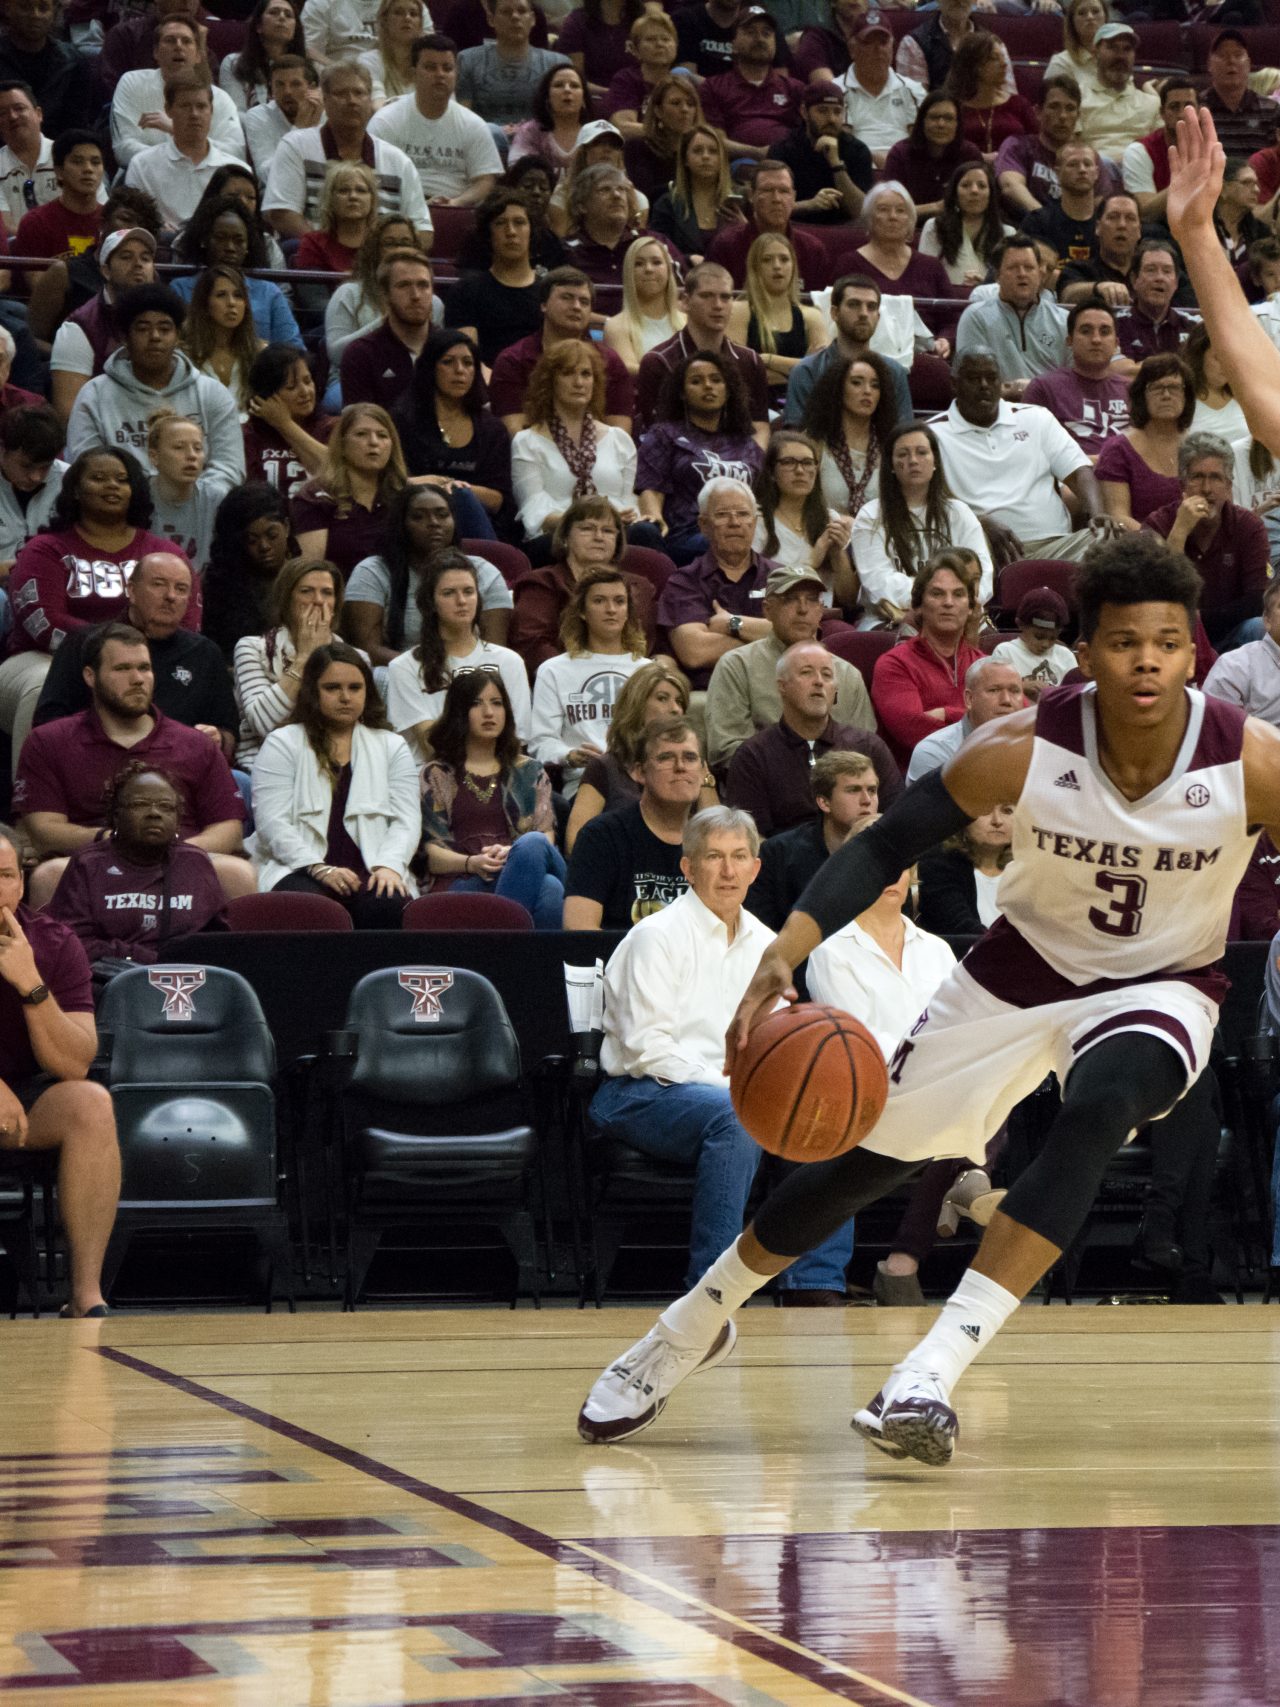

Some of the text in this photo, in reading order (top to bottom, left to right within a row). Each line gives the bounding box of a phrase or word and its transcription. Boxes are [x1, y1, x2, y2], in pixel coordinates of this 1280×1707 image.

[262, 448, 298, 460] EXAS
[566, 703, 597, 726] REED
[1032, 824, 1224, 872] TEXAS A&M
[104, 892, 157, 910] TEXAS
[1087, 869, 1148, 938] 3
